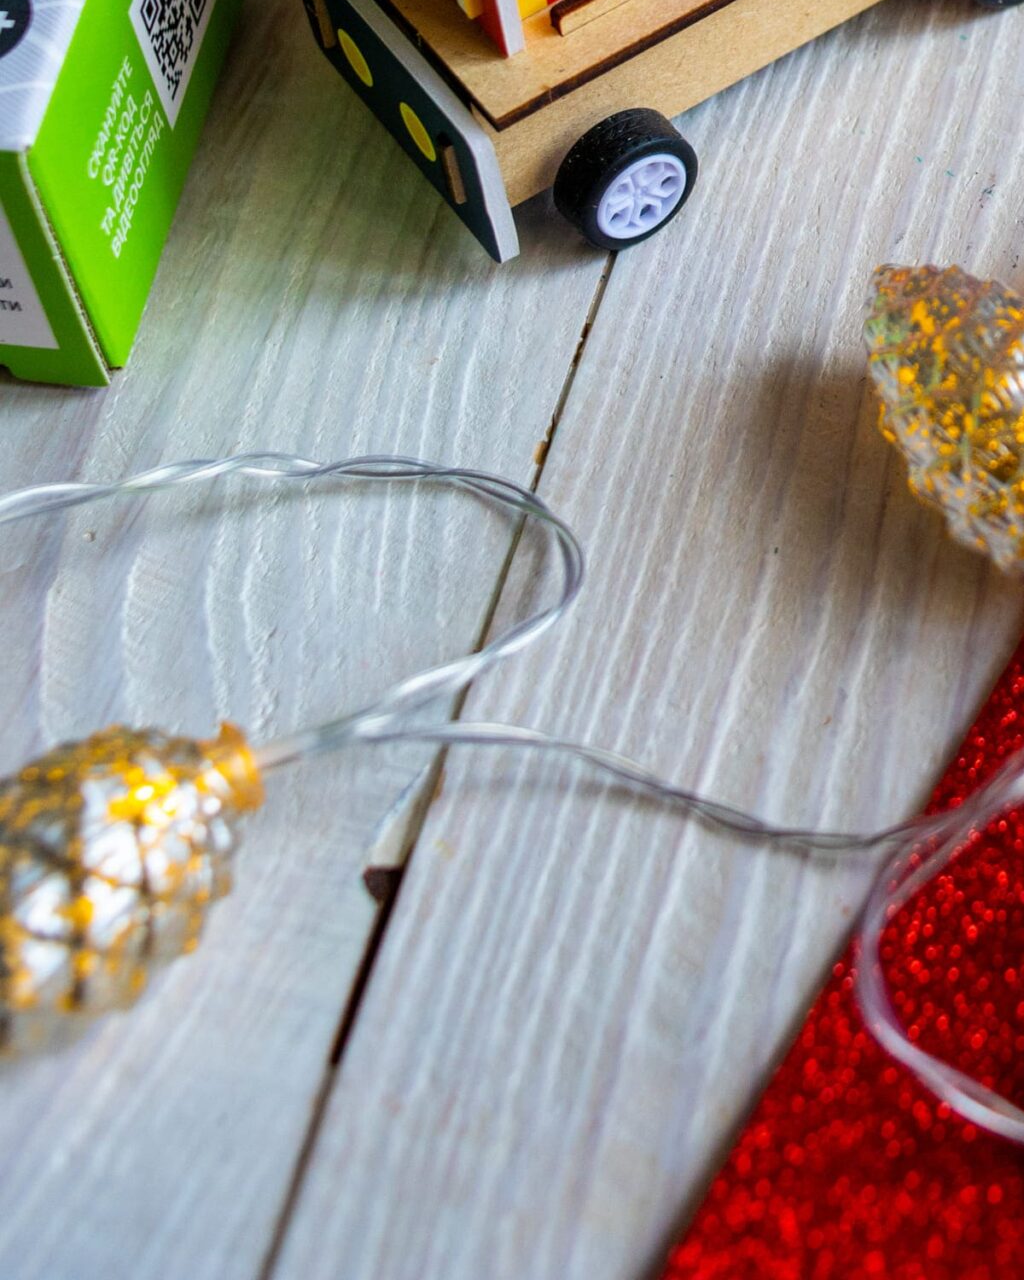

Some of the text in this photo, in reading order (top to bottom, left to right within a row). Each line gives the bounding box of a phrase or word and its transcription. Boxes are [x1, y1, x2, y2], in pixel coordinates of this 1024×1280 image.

[88, 56, 133, 179] СКАНУЙТЕ
[101, 206, 116, 235] ТА
[111, 110, 164, 259] ВІДЕООГЛЯД
